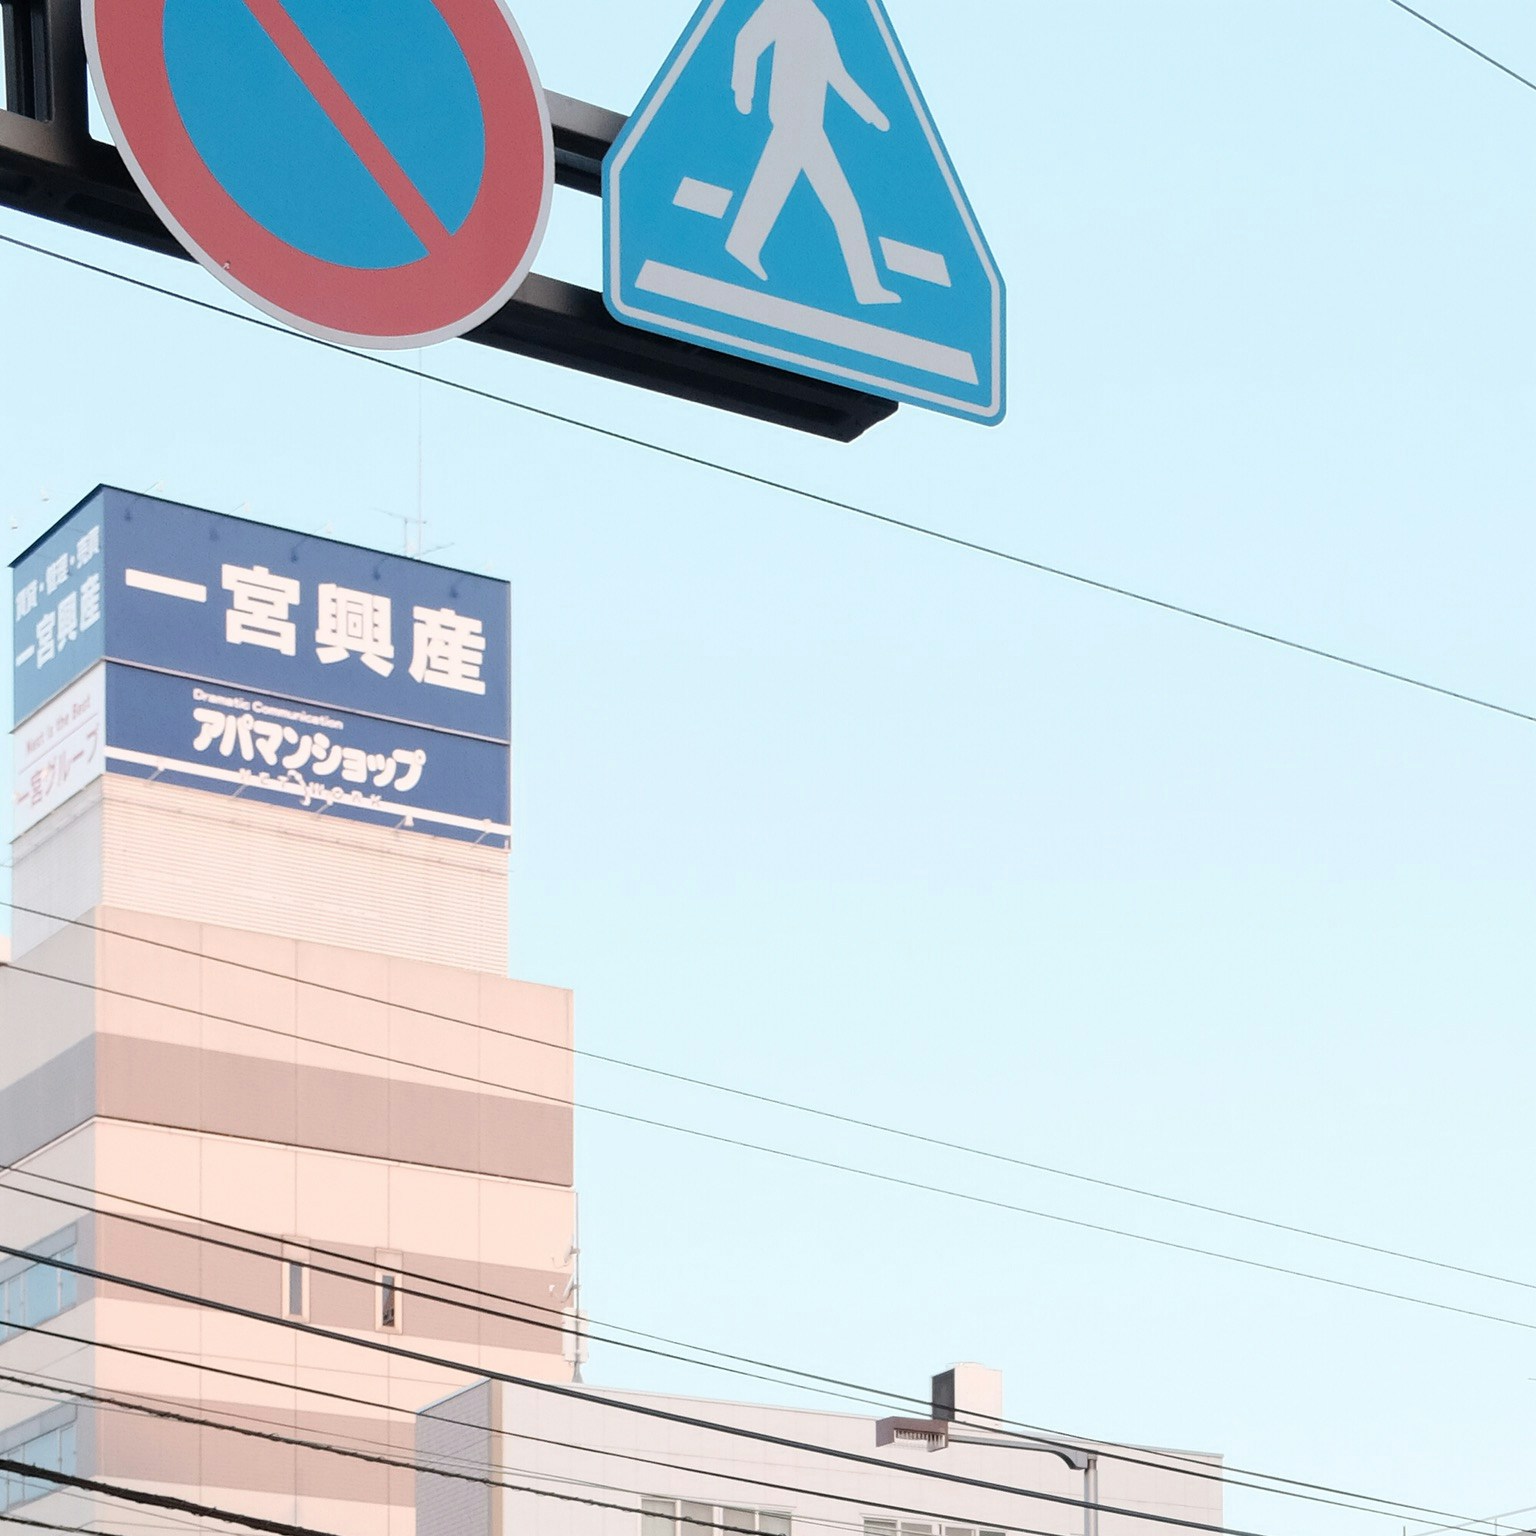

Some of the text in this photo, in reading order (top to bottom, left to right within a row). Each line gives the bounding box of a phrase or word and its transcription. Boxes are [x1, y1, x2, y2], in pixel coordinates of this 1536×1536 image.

[16, 573, 100, 669] 一宮興産
[125, 565, 486, 696] 一宮興産
[193, 707, 427, 792] アパマンショップ
